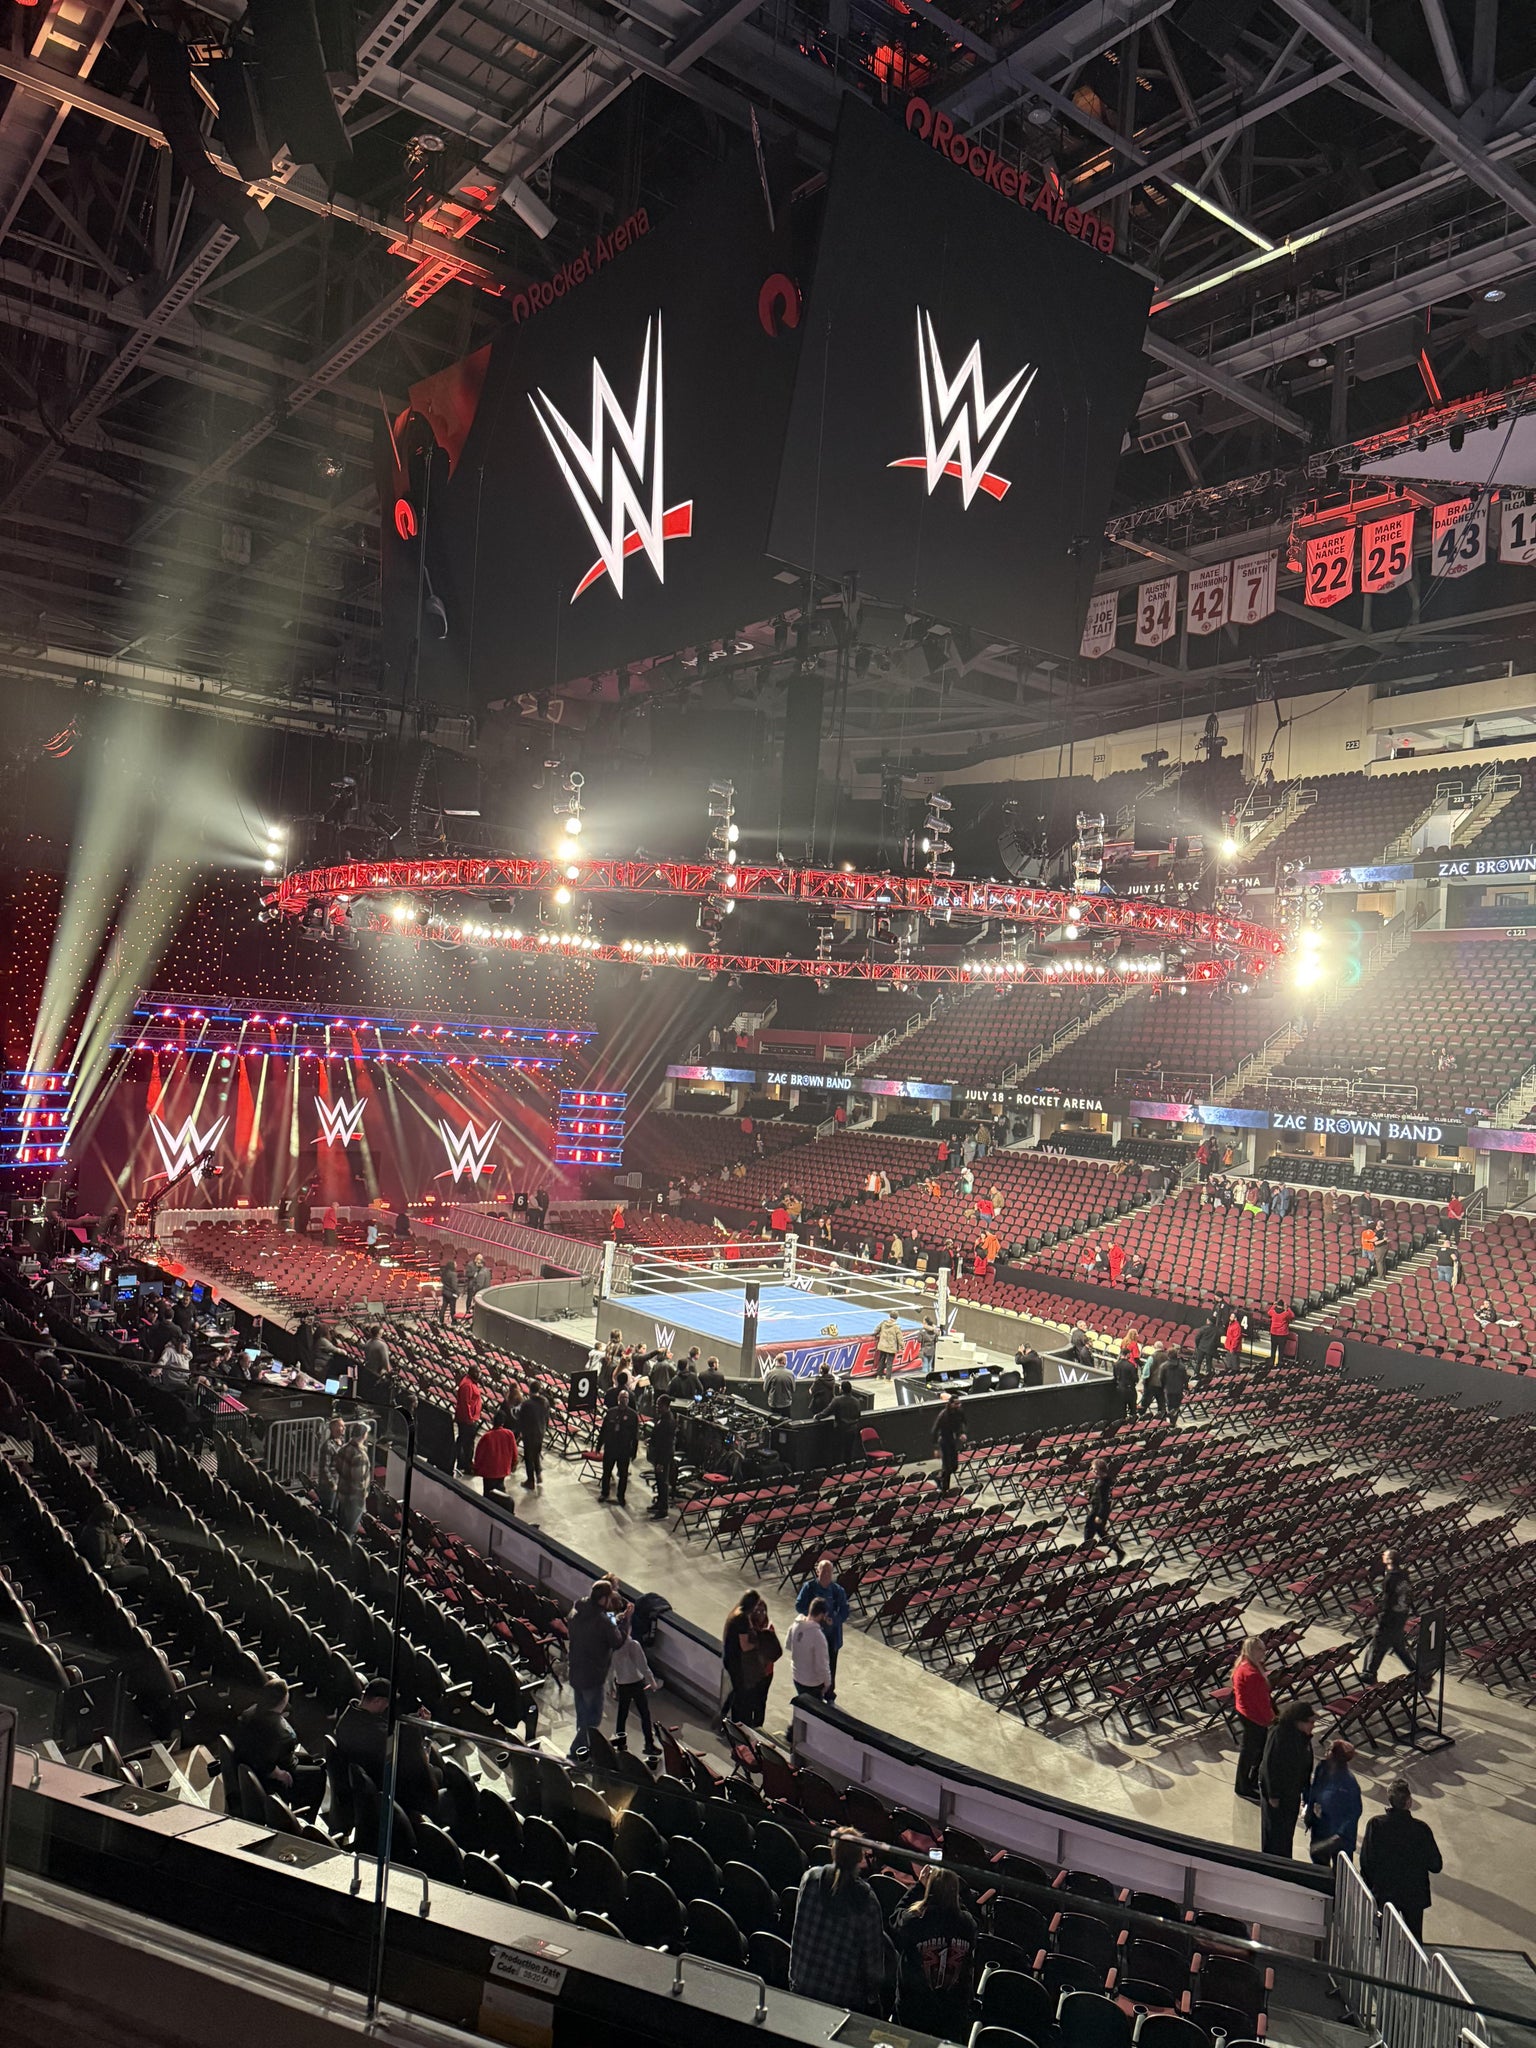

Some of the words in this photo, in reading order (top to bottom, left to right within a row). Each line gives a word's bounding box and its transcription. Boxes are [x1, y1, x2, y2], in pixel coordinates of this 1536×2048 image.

[932, 111, 1031, 206] Rocket
[1032, 180, 1115, 254] Arena
[528, 248, 594, 315] Rocket
[595, 207, 650, 268] Arena
[1447, 502, 1475, 516] BRAD
[1374, 520, 1402, 535] MARK
[1316, 536, 1346, 551] LARRY
[1374, 530, 1402, 545] PRICE
[1437, 523, 1480, 564] 43
[1315, 545, 1346, 560] NANCE
[1367, 541, 1407, 582] 25
[1200, 568, 1220, 580] NATE
[1242, 565, 1268, 578] SMITH
[1311, 557, 1348, 594] 22
[1145, 582, 1171, 595] AUSTIN
[1190, 575, 1228, 591] THURMOND
[1148, 591, 1167, 602] CARR
[1247, 577, 1262, 610] 7
[1190, 587, 1224, 622] 42
[1094, 609, 1113, 624] JOE
[1141, 600, 1171, 635] 34
[1092, 620, 1114, 635] TAIT
[1439, 862, 1470, 876] ZAC
[1475, 858, 1536, 874] BROWN
[1127, 884, 1151, 895] JULY
[767, 1072, 788, 1084] ZAC
[790, 1073, 824, 1087] BROWN
[826, 1076, 852, 1090] BAND
[965, 1089, 989, 1101] JULY
[992, 1091, 1004, 1102] 18
[1016, 1093, 1060, 1108] ROCKET
[1063, 1097, 1103, 1111] ARENA
[1273, 1113, 1307, 1130] ZAC
[1313, 1116, 1382, 1137] BROWN
[1388, 1122, 1443, 1142] BAND
[285, 1200, 293, 1211] 7
[517, 1195, 524, 1206] 6
[1240, 1315, 1249, 1330] 4
[577, 1377, 590, 1398] 9
[1428, 1620, 1437, 1650] 1
[500, 1951, 542, 1971] Production
[542, 1965, 561, 1979] Date
